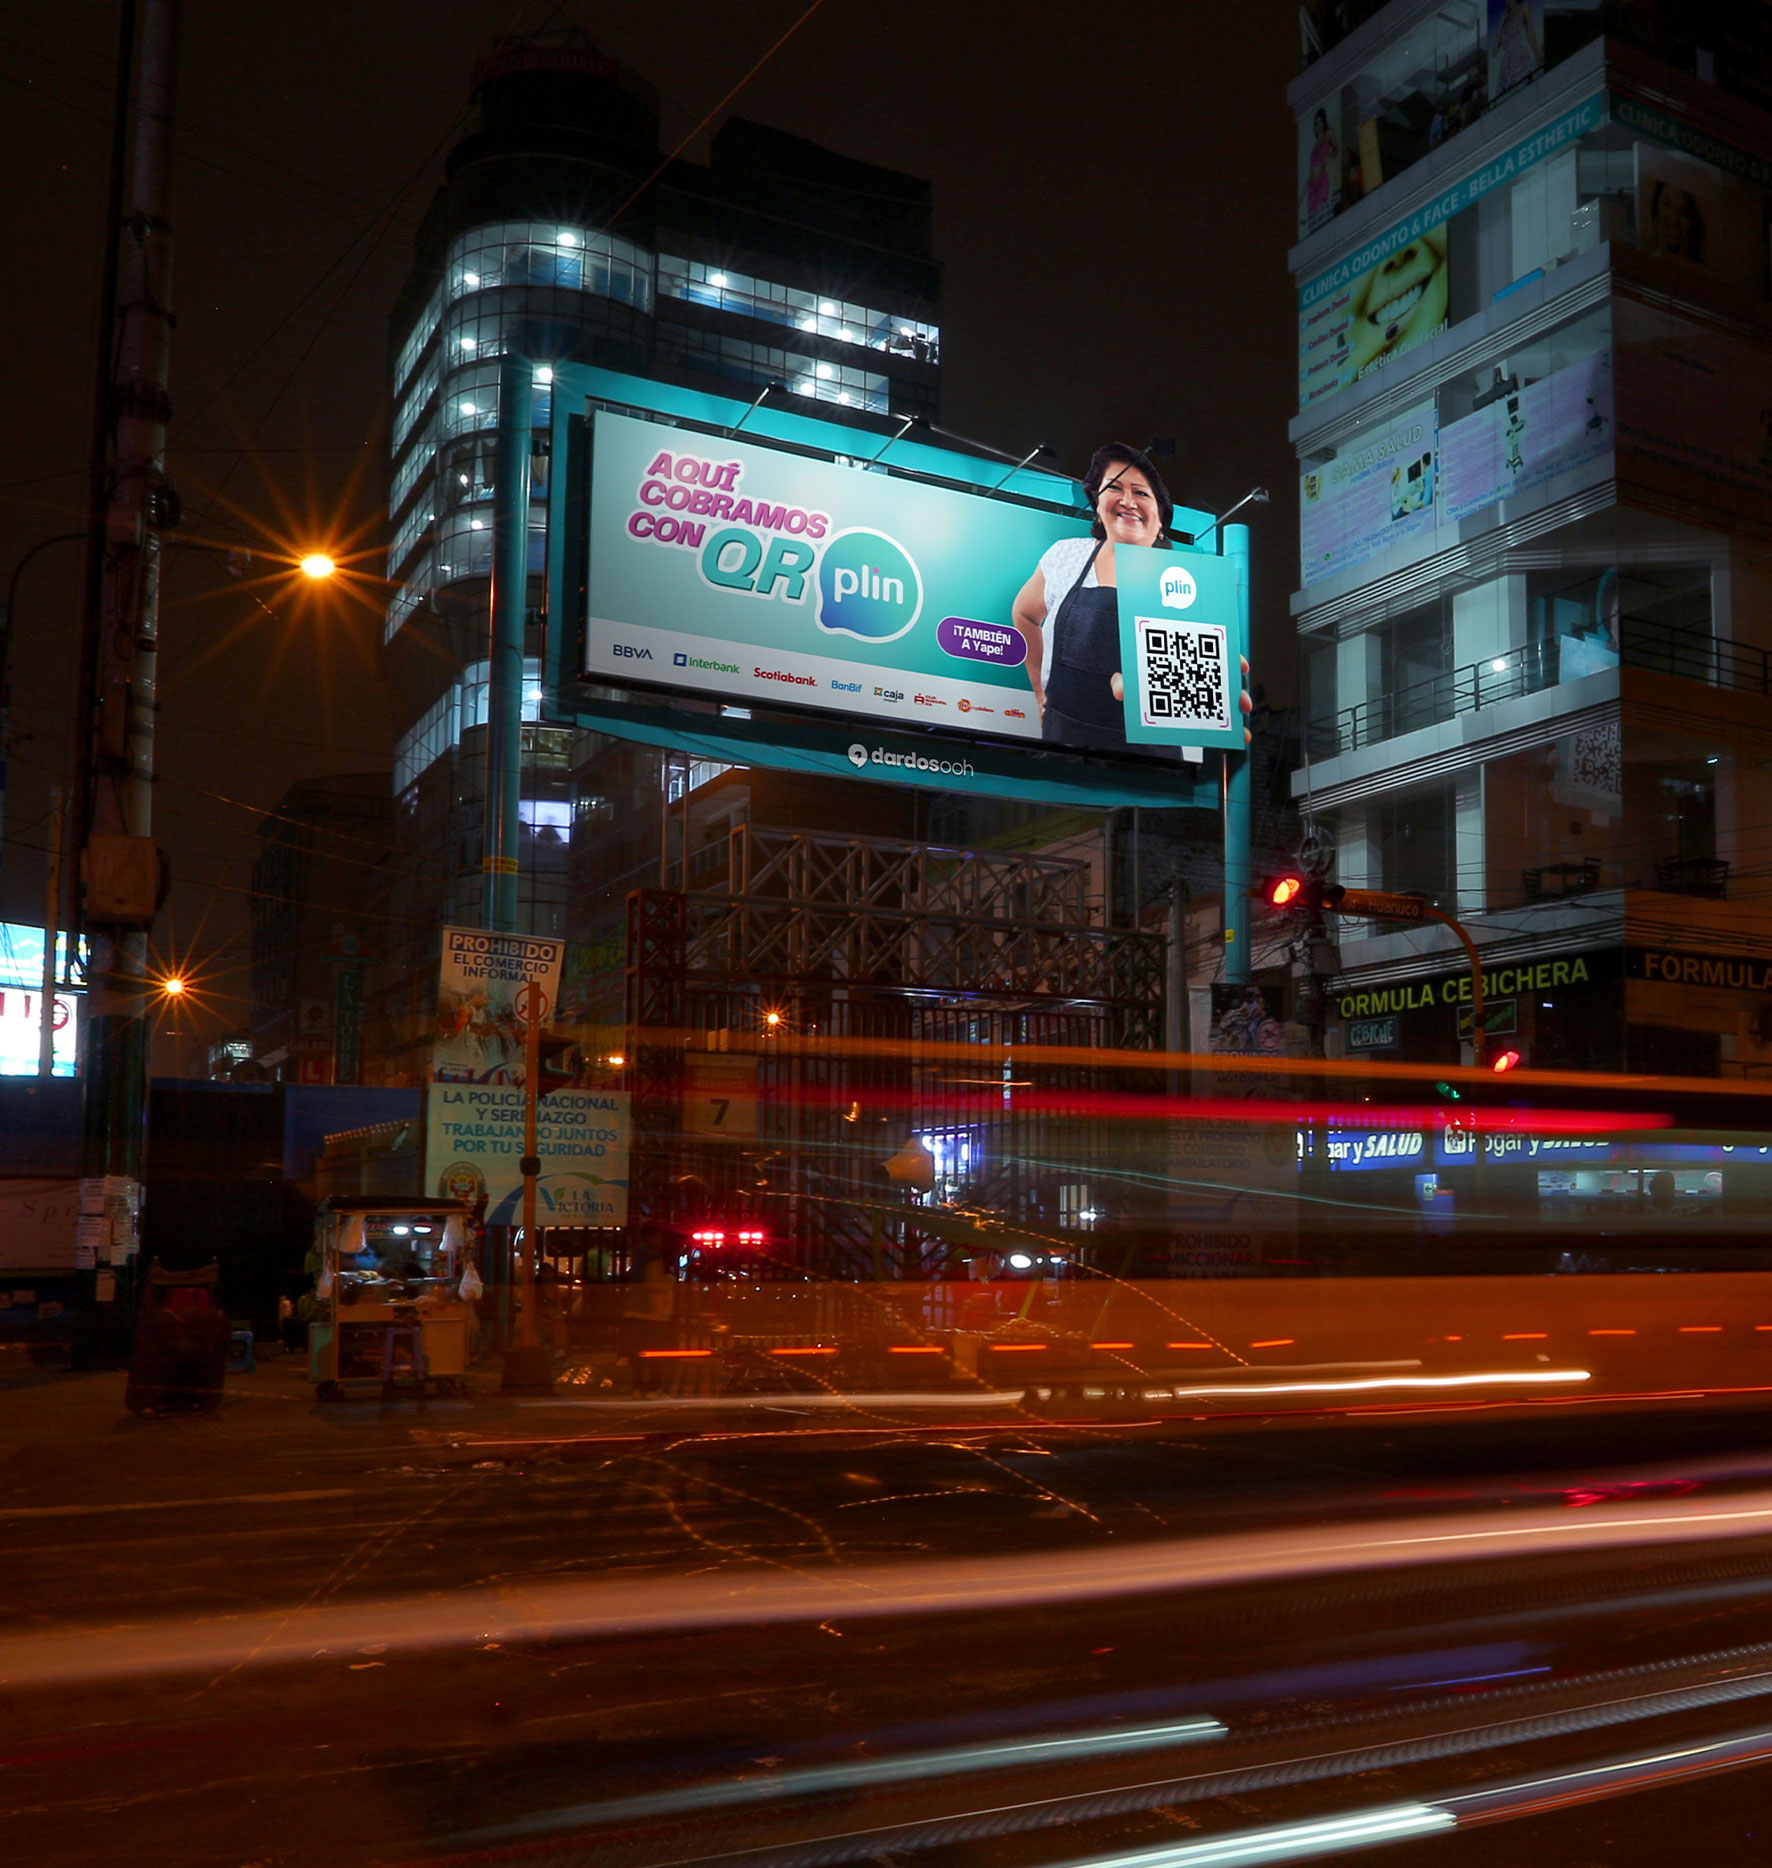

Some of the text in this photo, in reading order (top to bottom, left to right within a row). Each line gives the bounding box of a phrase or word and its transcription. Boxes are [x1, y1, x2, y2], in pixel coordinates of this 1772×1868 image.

[1303, 265, 1350, 304] CLINICA
[1351, 228, 1411, 273] ODONTO
[1410, 218, 1421, 237] &
[1423, 191, 1460, 229] FACE
[1468, 160, 1515, 199] BELLA
[1519, 106, 1593, 178] ESTHETIC
[1377, 426, 1425, 461] SALUD
[647, 452, 740, 492] AQUÍ
[639, 480, 829, 538] COBRAMOS
[628, 511, 815, 600] CON QR
[834, 564, 904, 604] plin
[1165, 580, 1191, 596] plin
[953, 624, 1011, 645] ¡TAMBIÉN
[613, 644, 653, 660] BBVA
[961, 638, 1004, 656] A Yape!
[689, 656, 740, 675] Interbank
[831, 680, 863, 693] BanBif
[883, 688, 904, 701] caja
[871, 746, 974, 777] dardosooh
[452, 934, 554, 960] PROHIBIDO
[453, 953, 549, 974] EL COMERCIO
[1340, 985, 1435, 1018] ORMULA
[443, 1091, 465, 1104] LA
[537, 1093, 619, 1111] NACIONAL
[475, 1109, 488, 1121] Y
[710, 1098, 729, 1126] 7
[556, 1128, 617, 1141] JUNTOS
[453, 1139, 606, 1157] POR TU SGURIDAD
[1351, 1142, 1364, 1165] y
[1363, 1132, 1423, 1158] SALUD
[572, 1190, 593, 1200] LA
